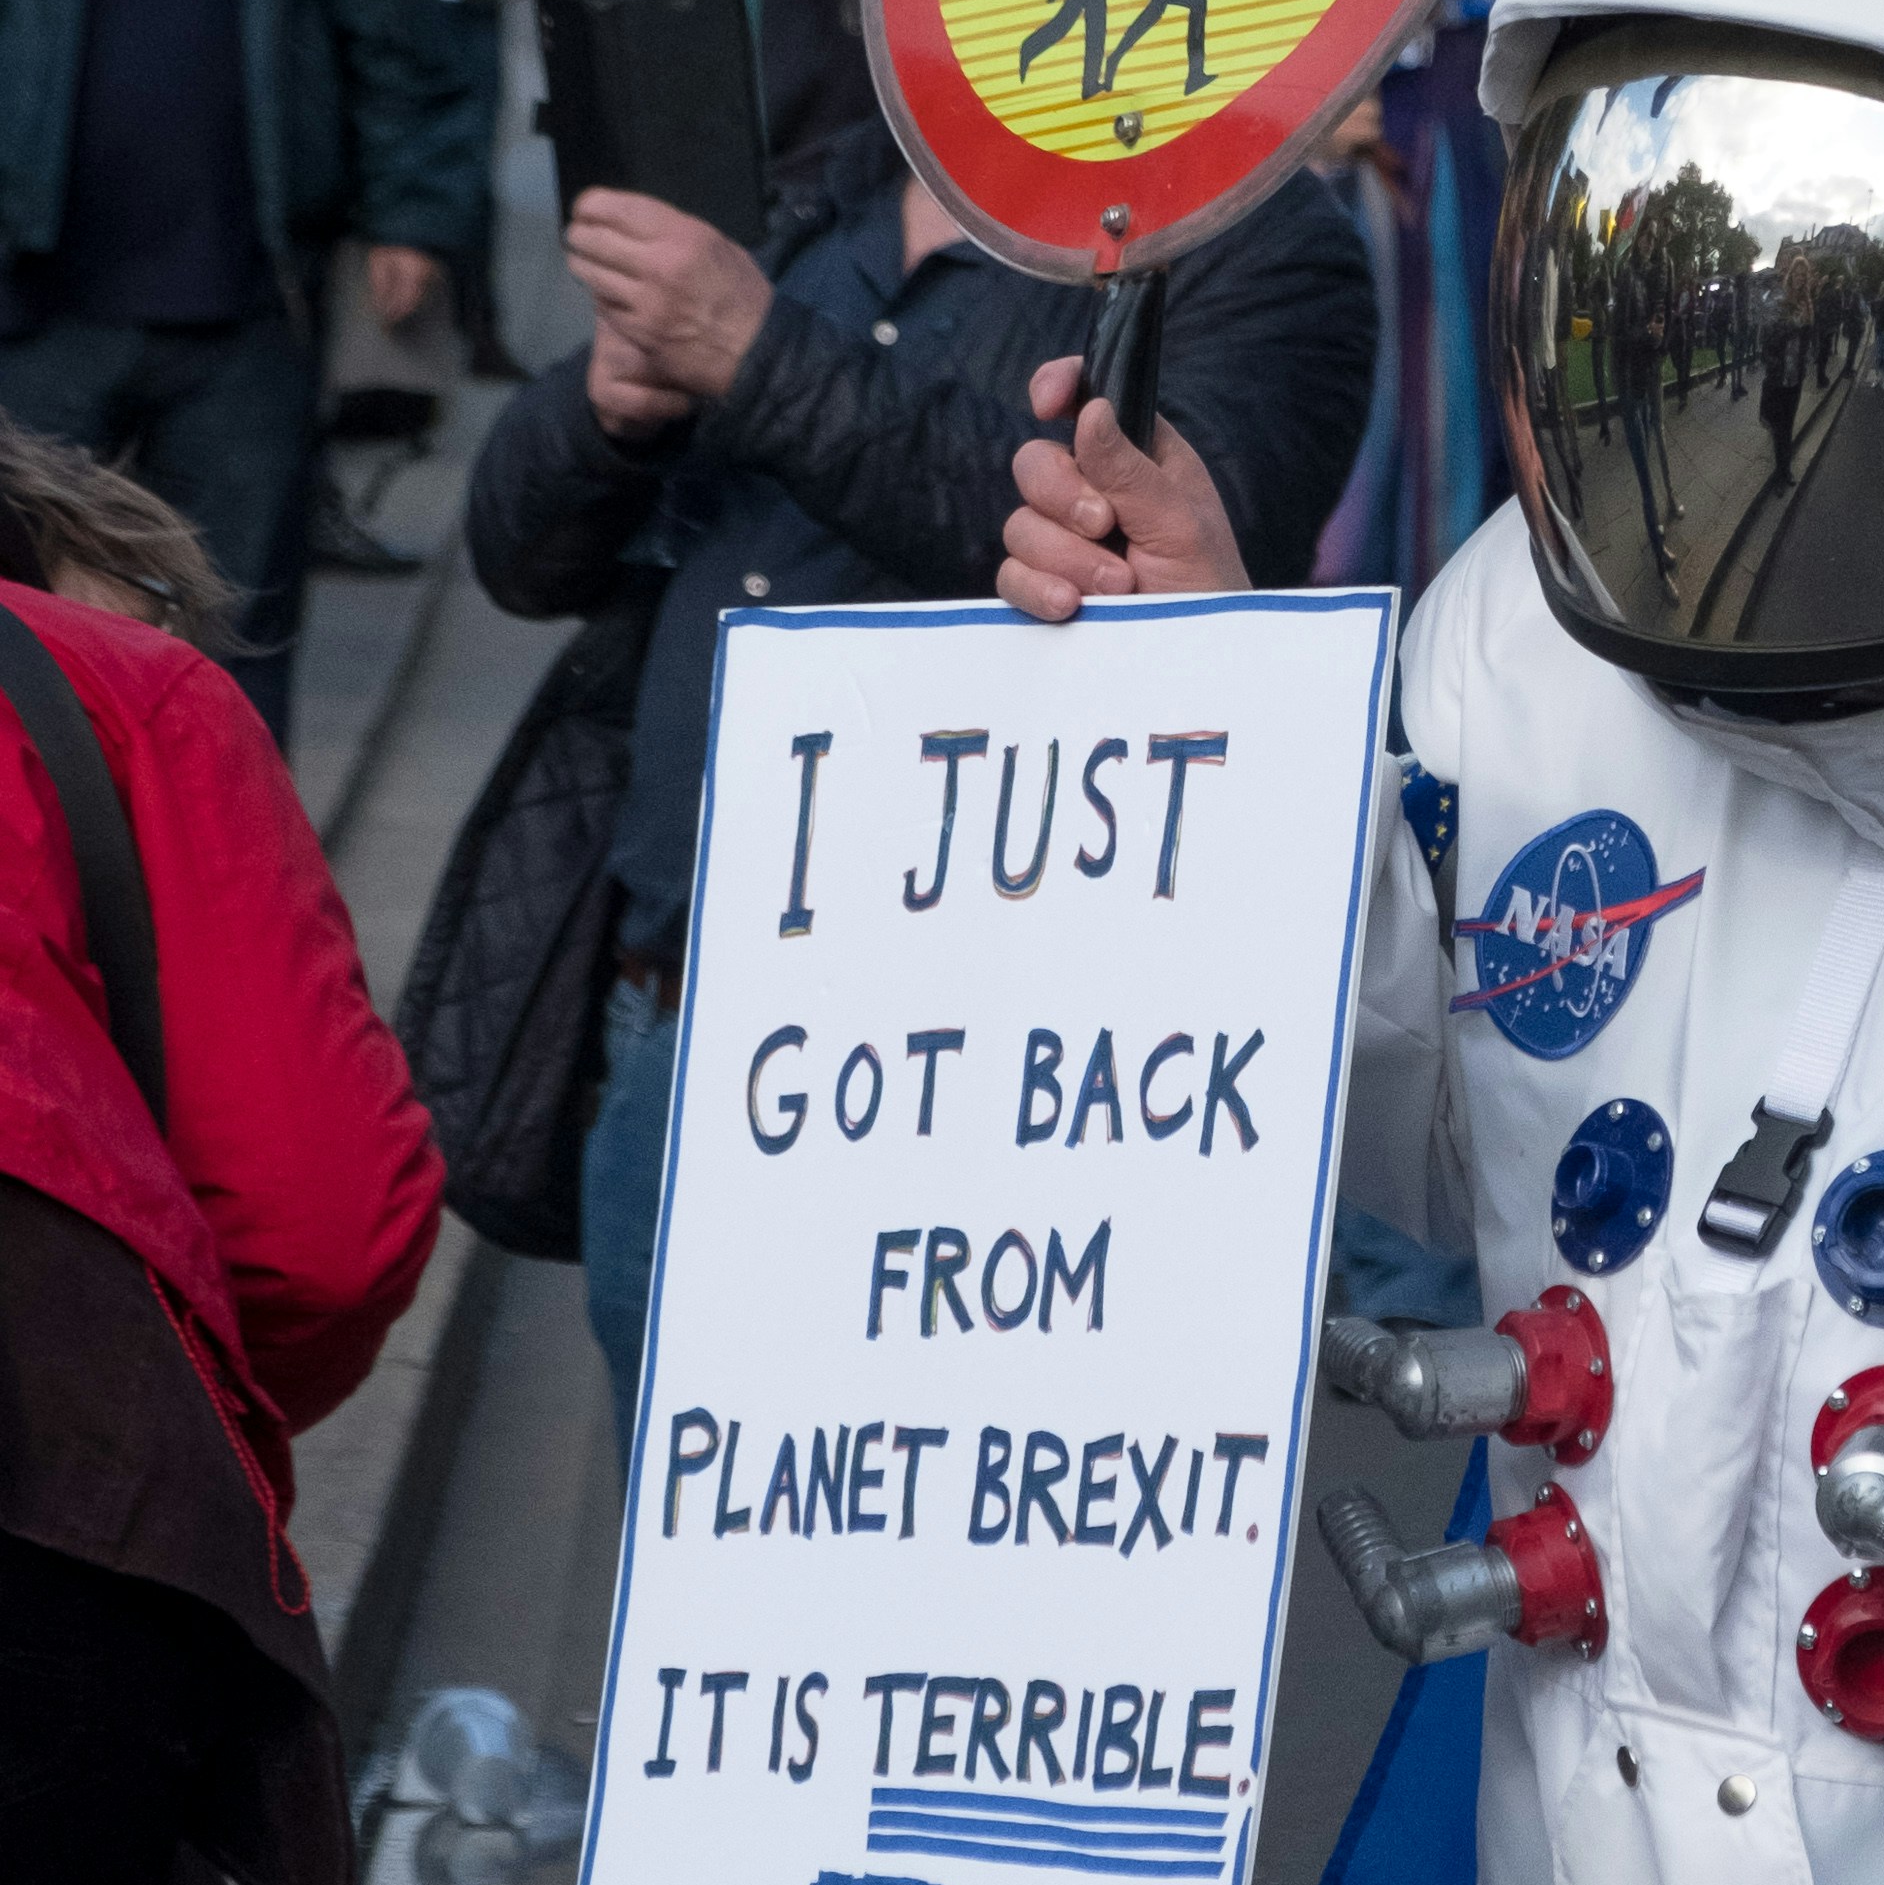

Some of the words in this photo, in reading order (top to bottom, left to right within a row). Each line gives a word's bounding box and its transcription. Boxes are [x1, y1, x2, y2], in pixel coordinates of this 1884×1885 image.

[779, 730, 834, 938] I
[902, 729, 1230, 913] JUST
[1494, 884, 1630, 981] NASA
[746, 1024, 967, 1156] GOT
[1014, 1027, 1265, 1158] BACK
[865, 1216, 1113, 1342] FROM
[661, 1406, 949, 1541] PLANET
[967, 1425, 1271, 1560] BREXIT.
[643, 1667, 751, 1780] IT
[768, 1671, 830, 1785] IS
[862, 1671, 1252, 1799] TERRIBLE.
